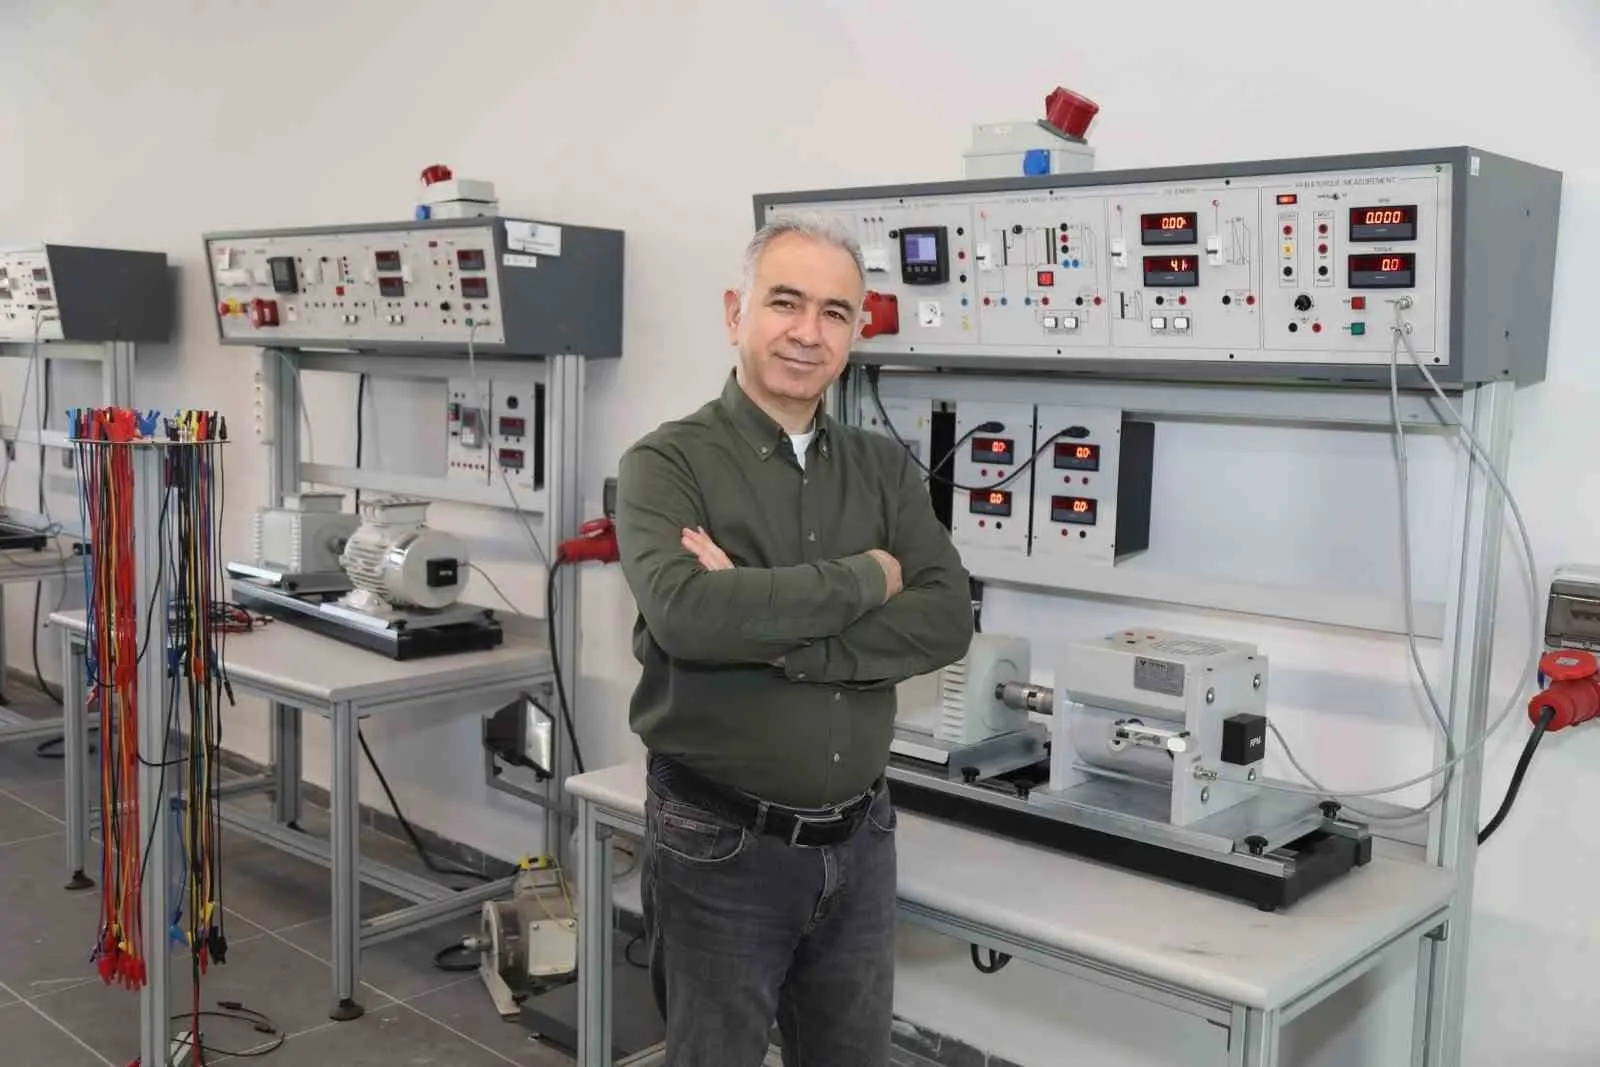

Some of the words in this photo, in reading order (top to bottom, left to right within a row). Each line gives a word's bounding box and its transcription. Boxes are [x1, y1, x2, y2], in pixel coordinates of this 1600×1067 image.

[1365, 211, 1401, 224] 0.000
[1382, 259, 1399, 271] 0.0
[1249, 735, 1262, 750] RPM
